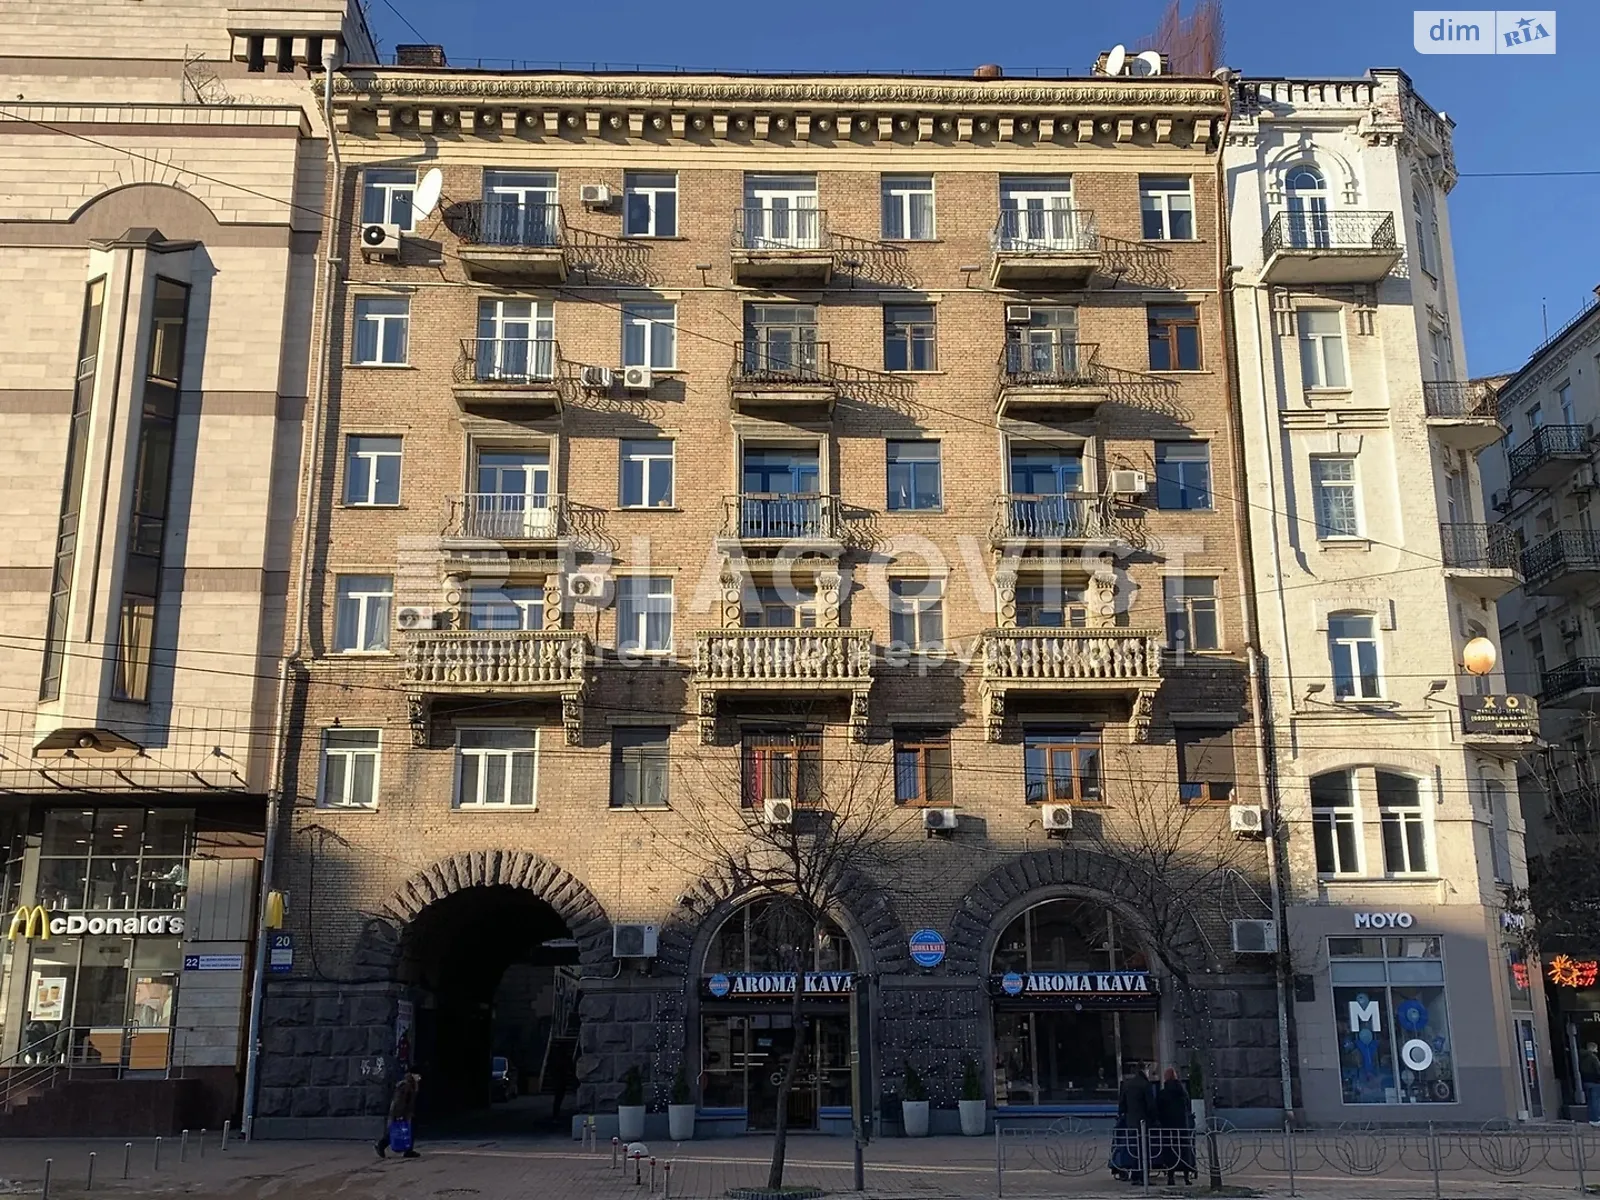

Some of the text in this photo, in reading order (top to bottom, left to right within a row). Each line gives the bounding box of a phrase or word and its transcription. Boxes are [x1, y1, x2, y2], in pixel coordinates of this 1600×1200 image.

[8, 905, 185, 940] McDonald's
[1354, 912, 1413, 929] MOYO
[275, 936, 290, 947] 20
[186, 958, 198, 967] 22
[732, 976, 852, 992] AROMA KAVA
[1025, 975, 1148, 991] AROMA KAVA
